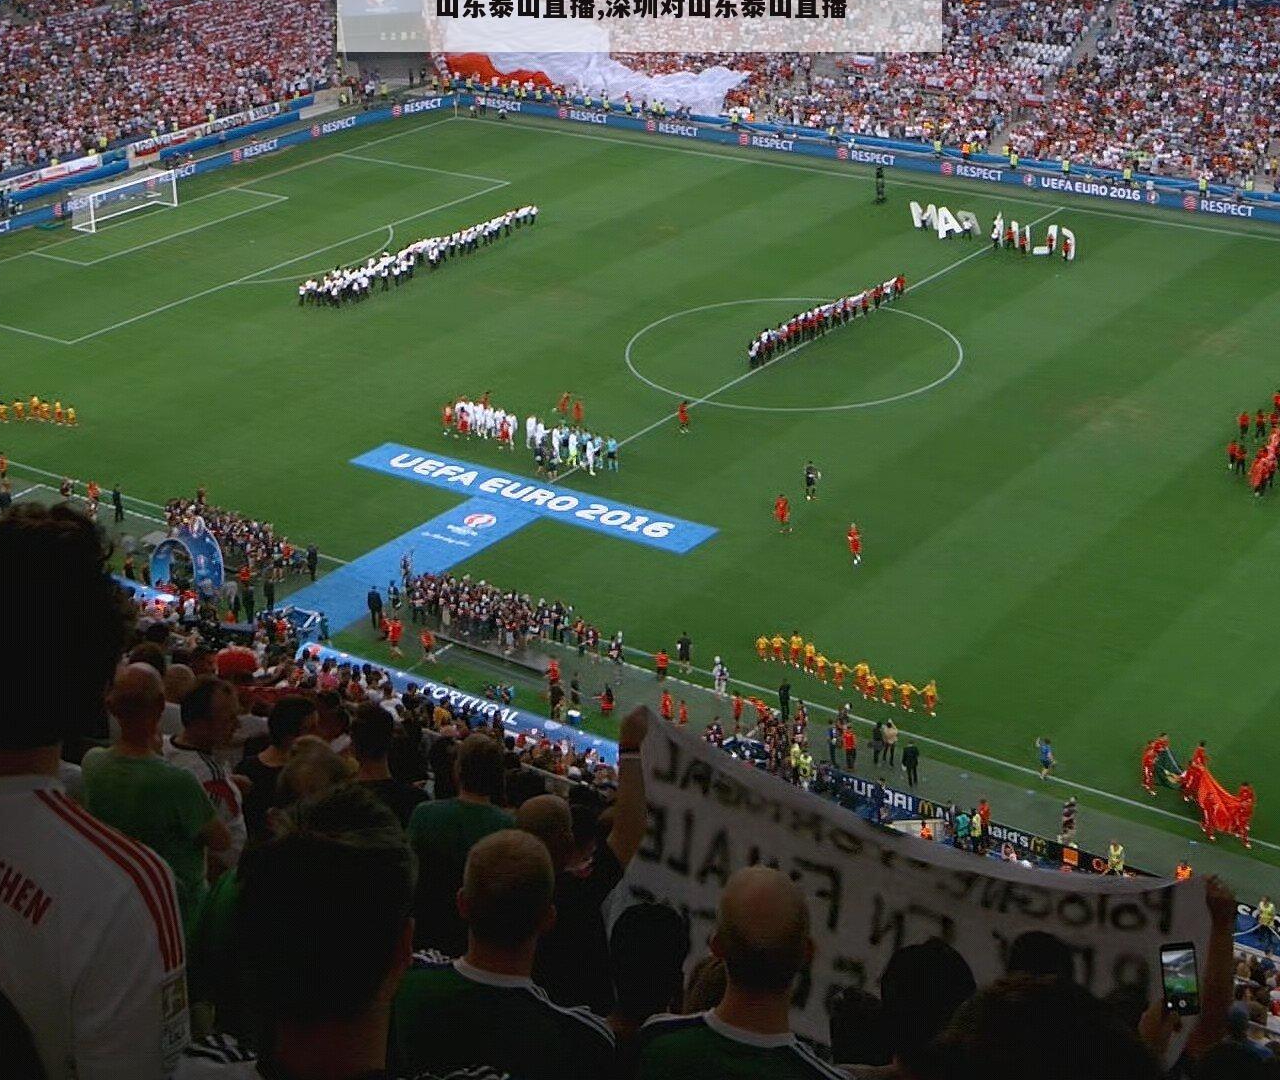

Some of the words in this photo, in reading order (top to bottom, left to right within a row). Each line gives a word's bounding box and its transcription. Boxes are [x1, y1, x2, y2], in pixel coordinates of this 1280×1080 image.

[404, 99, 442, 114] RESPECT
[322, 116, 357, 133] RESPECT
[570, 108, 608, 124] RESPECT
[658, 122, 698, 137] RESPECT
[243, 139, 279, 158] RESPECT
[752, 135, 795, 152] RESPECT
[850, 149, 895, 166] RESPECT
[956, 164, 1003, 182] RESPECT
[1041, 176, 1073, 192] UEFA
[1074, 180, 1108, 198] EURO
[1110, 184, 1141, 201] 2016
[1200, 199, 1254, 217] RESPECT
[390, 453, 478, 487] UEFA
[478, 476, 580, 513] EURO
[575, 502, 676, 539] 2016
[419, 681, 519, 726] PORTUGAL
